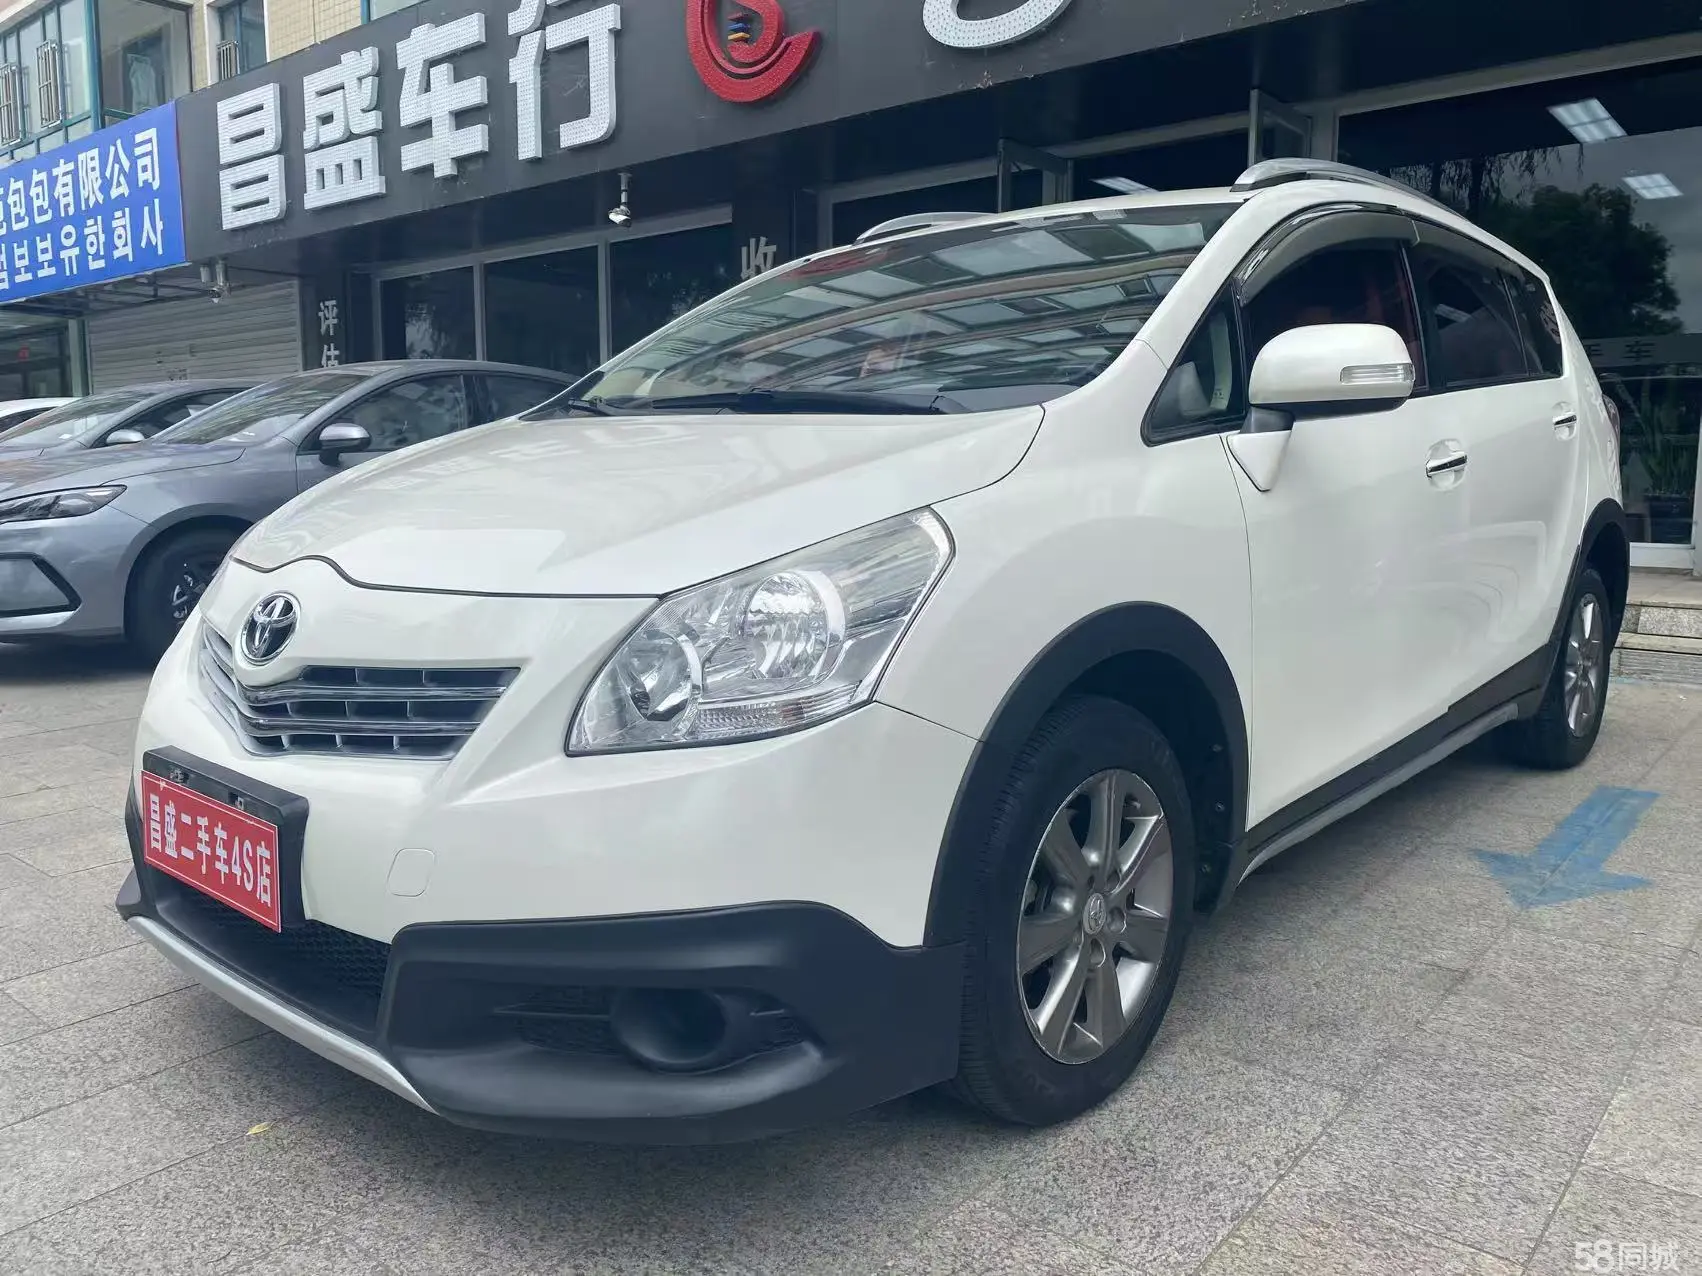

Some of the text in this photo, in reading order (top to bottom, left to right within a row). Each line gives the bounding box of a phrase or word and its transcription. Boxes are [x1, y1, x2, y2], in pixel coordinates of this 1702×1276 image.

[217, 0, 622, 230] 昌盛车行
[740, 236, 777, 280] 收
[149, 793, 272, 907] 昌盛二手车4S店
